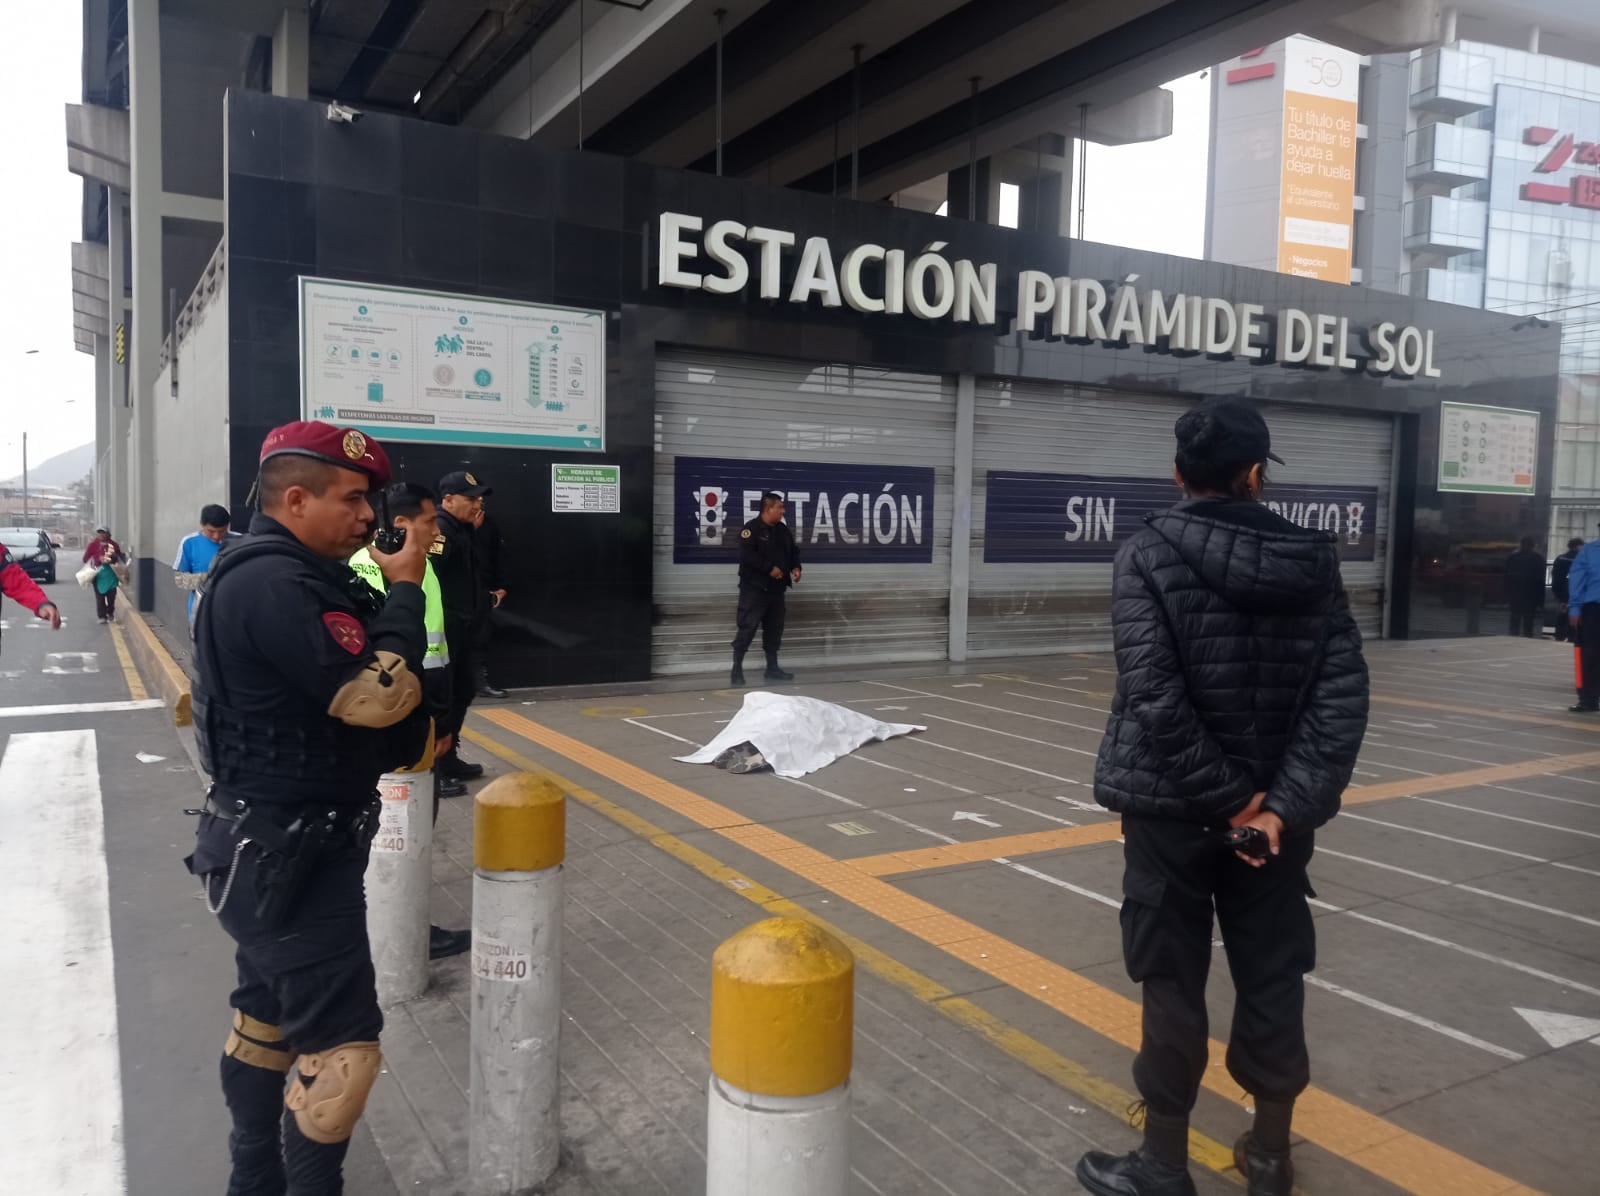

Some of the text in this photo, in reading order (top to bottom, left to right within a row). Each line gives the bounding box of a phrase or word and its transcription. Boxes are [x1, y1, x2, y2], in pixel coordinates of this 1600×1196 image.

[1288, 106, 1303, 123] Tu
[1335, 116, 1351, 131] de
[1287, 123, 1351, 148] Bachiller te
[1287, 143, 1333, 161] ayuda a
[1286, 157, 1352, 180] dejar huella
[1292, 255, 1328, 267] Negocios
[659, 211, 1441, 378] ESTACIÓN PIRÁMIDE DEL SOL
[743, 483, 922, 545] ETACIÓN
[1064, 495, 1115, 541] SIN
